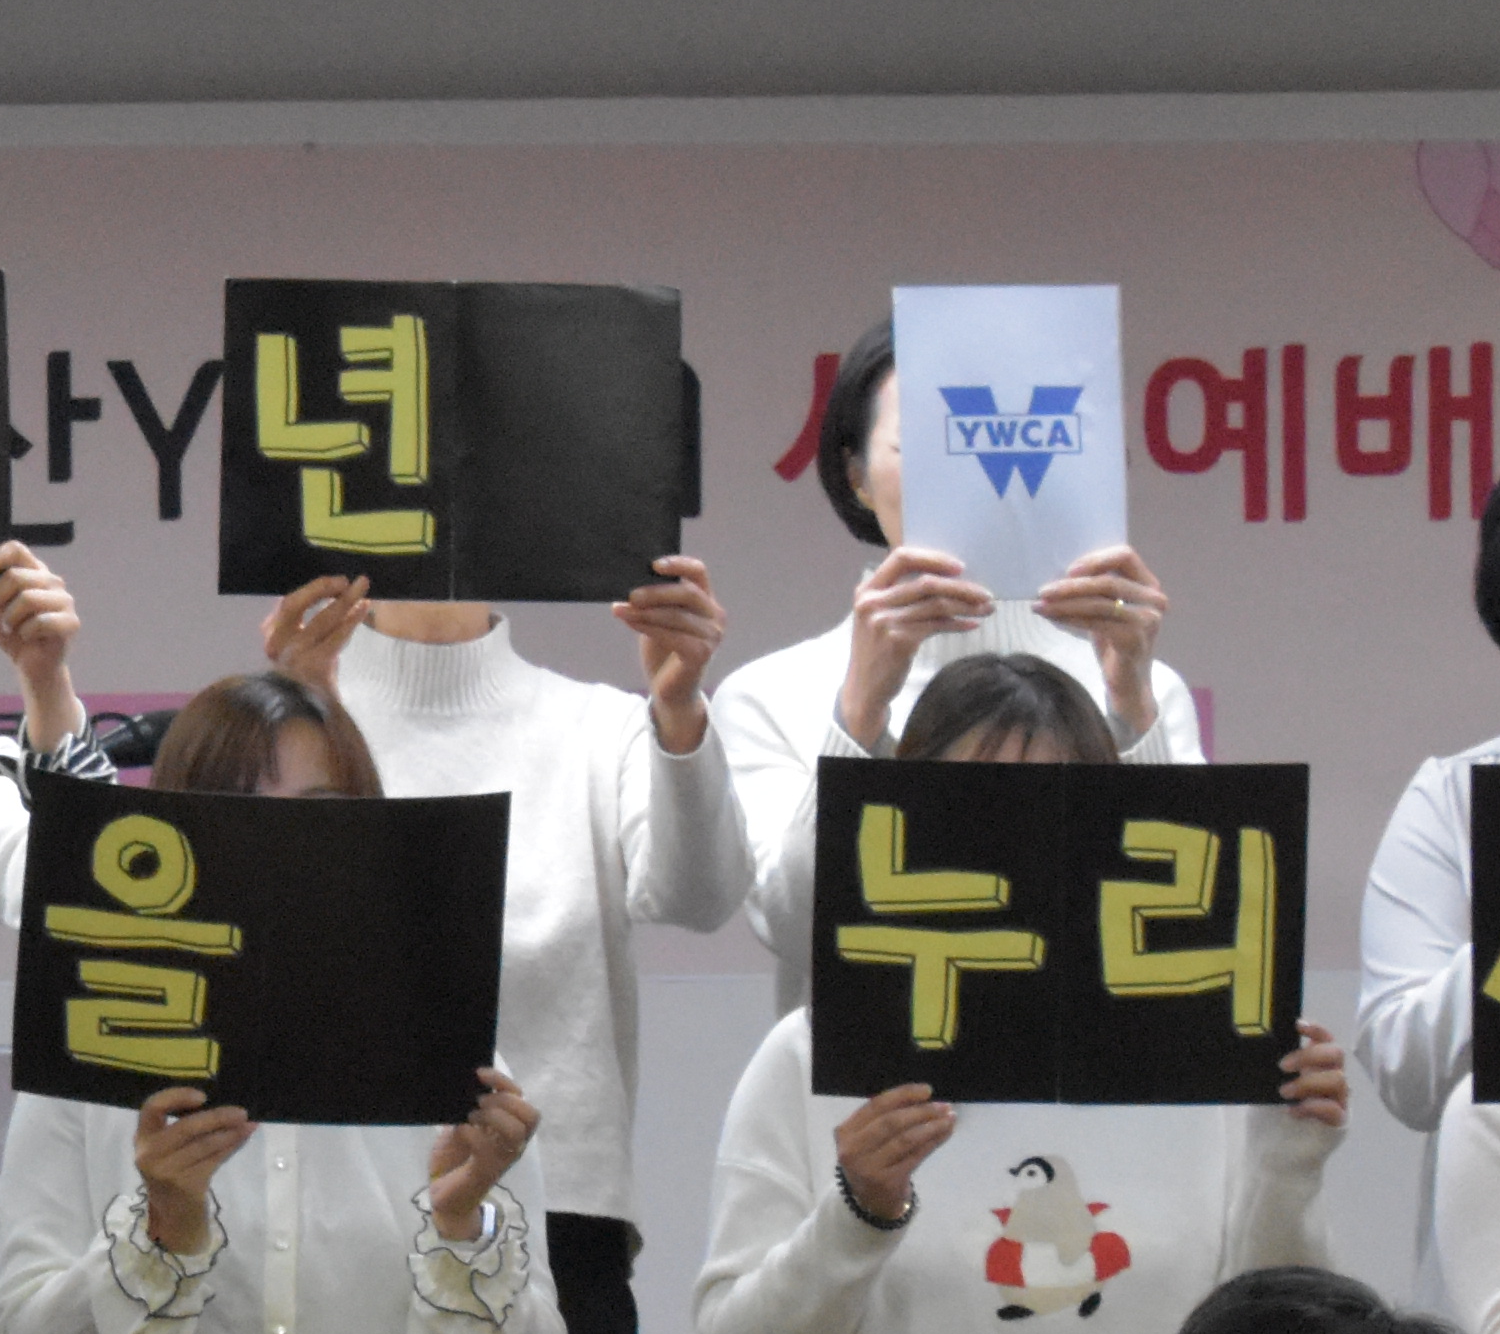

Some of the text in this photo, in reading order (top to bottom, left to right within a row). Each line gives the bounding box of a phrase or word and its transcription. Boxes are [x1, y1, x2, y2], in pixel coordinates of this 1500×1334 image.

[257, 315, 436, 555] 년
[956, 419, 1072, 448] YWCA
[46, 814, 243, 1079] 을
[837, 804, 1276, 1050] 누리
